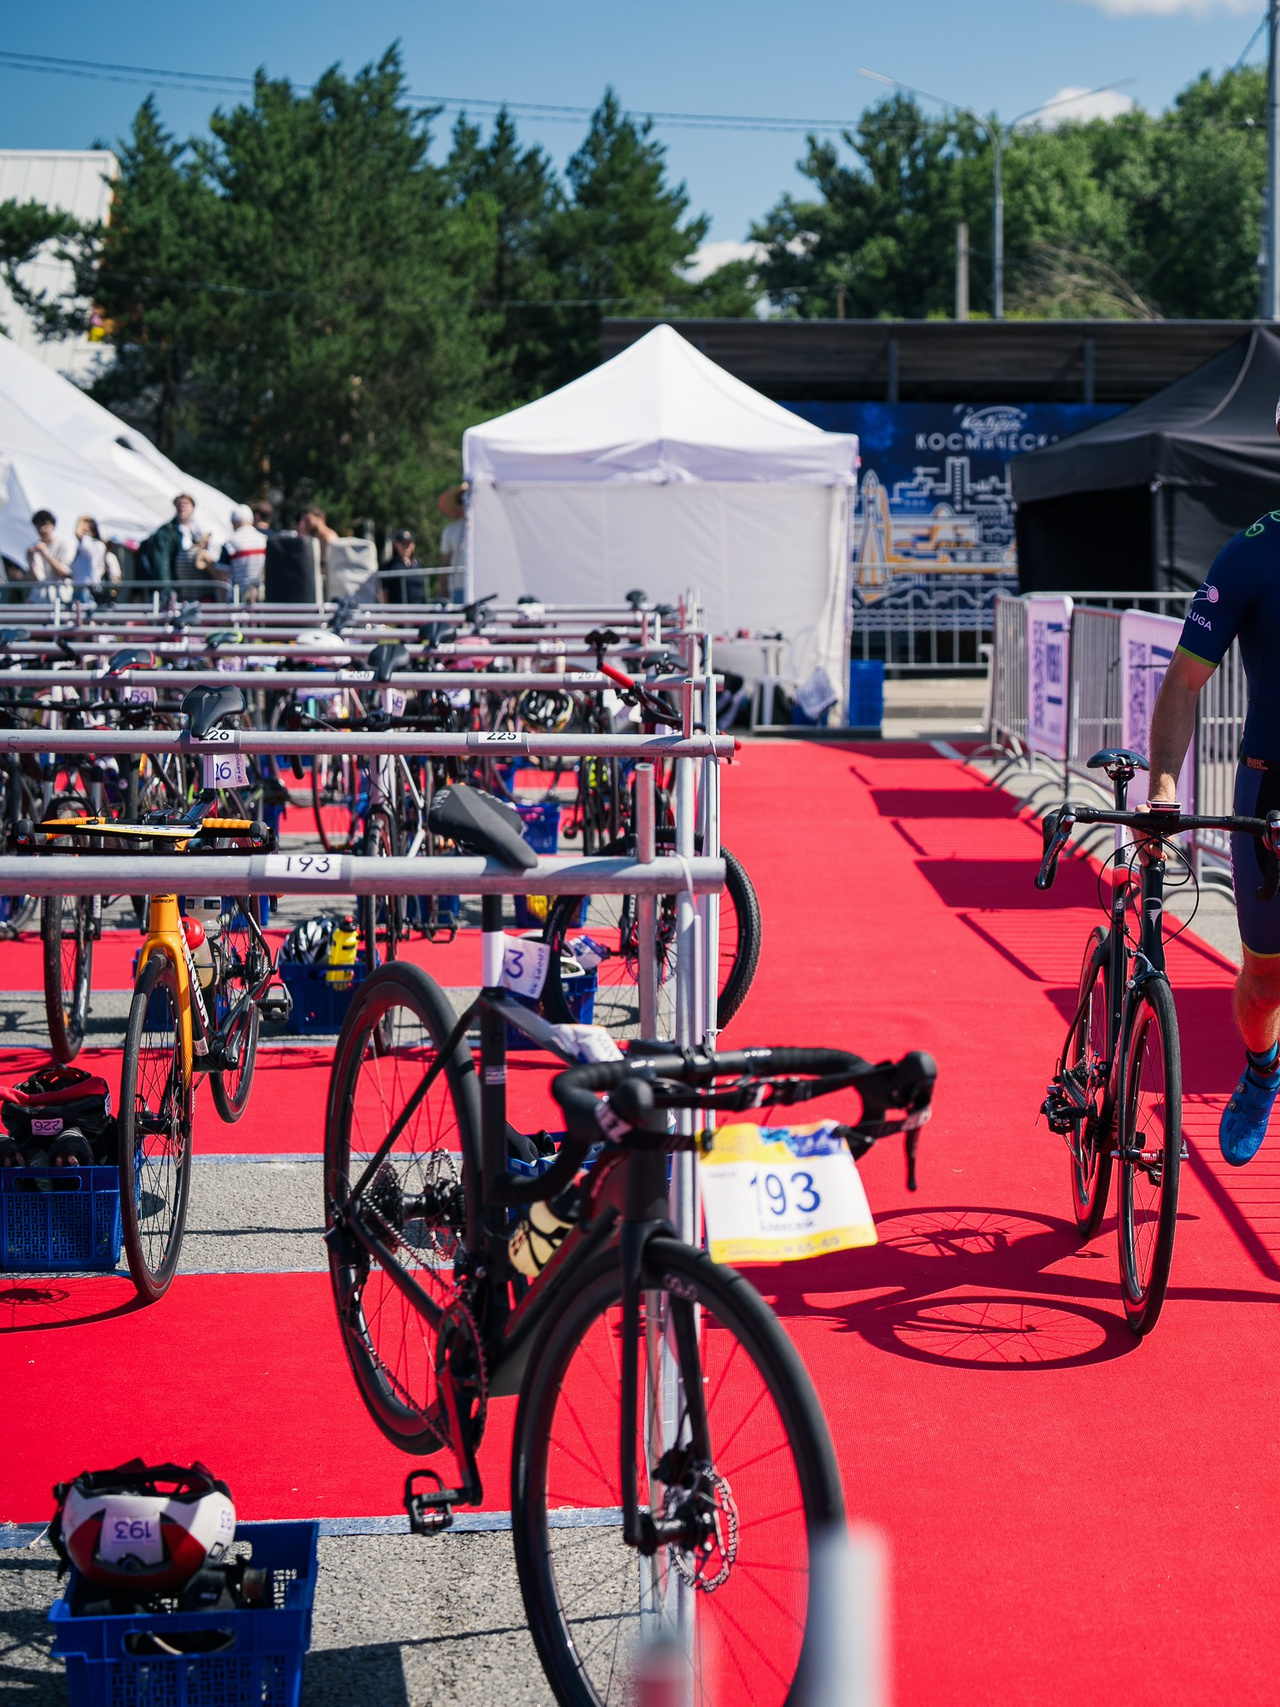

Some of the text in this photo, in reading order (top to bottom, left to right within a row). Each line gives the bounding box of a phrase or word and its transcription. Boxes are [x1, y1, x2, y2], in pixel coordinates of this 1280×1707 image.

[486, 731, 517, 742] 225
[286, 856, 330, 873] 193
[34, 1119, 61, 1132] 226
[749, 1171, 822, 1216] 193
[113, 1520, 154, 1540] 193
